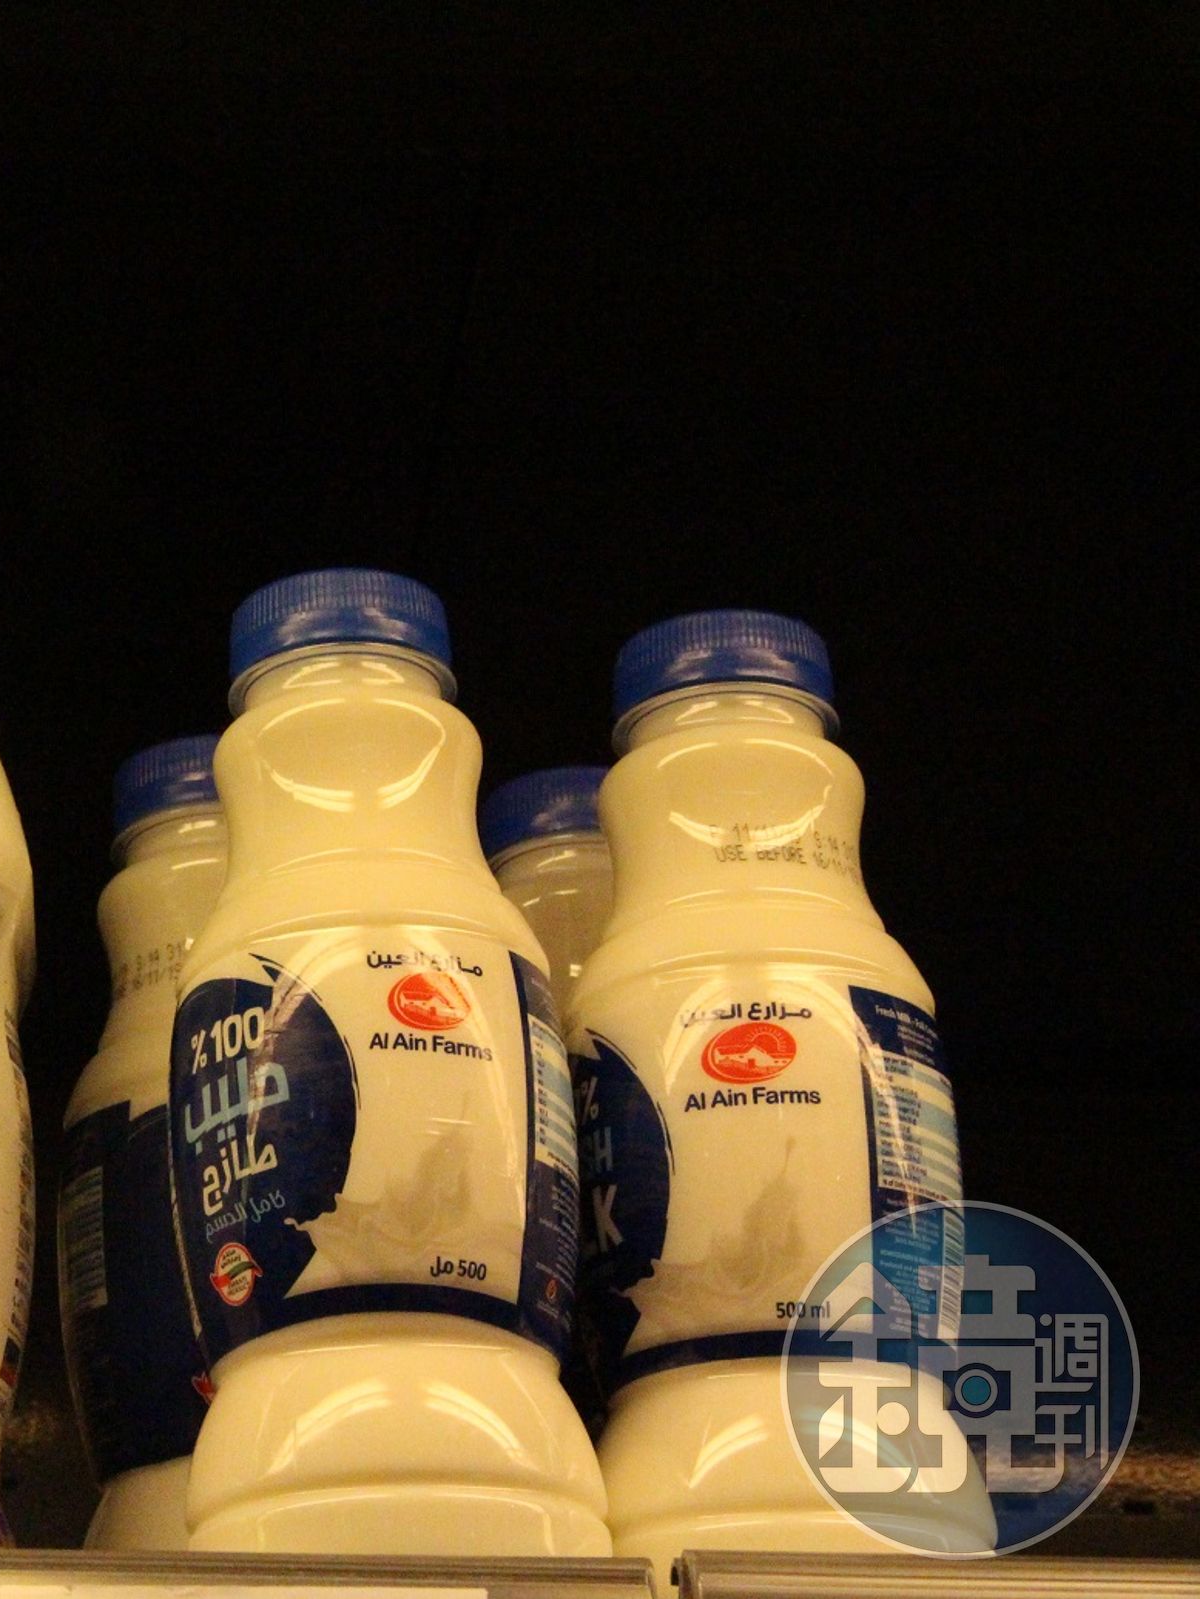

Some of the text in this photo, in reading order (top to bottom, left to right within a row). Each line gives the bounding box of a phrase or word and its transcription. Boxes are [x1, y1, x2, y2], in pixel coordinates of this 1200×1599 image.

[369, 1032, 493, 1062] Al Ain Farms
[684, 1086, 822, 1112] Al Ain Farms
[430, 1255, 487, 1281] 500 مل
[775, 1300, 831, 1319] 500 ml
